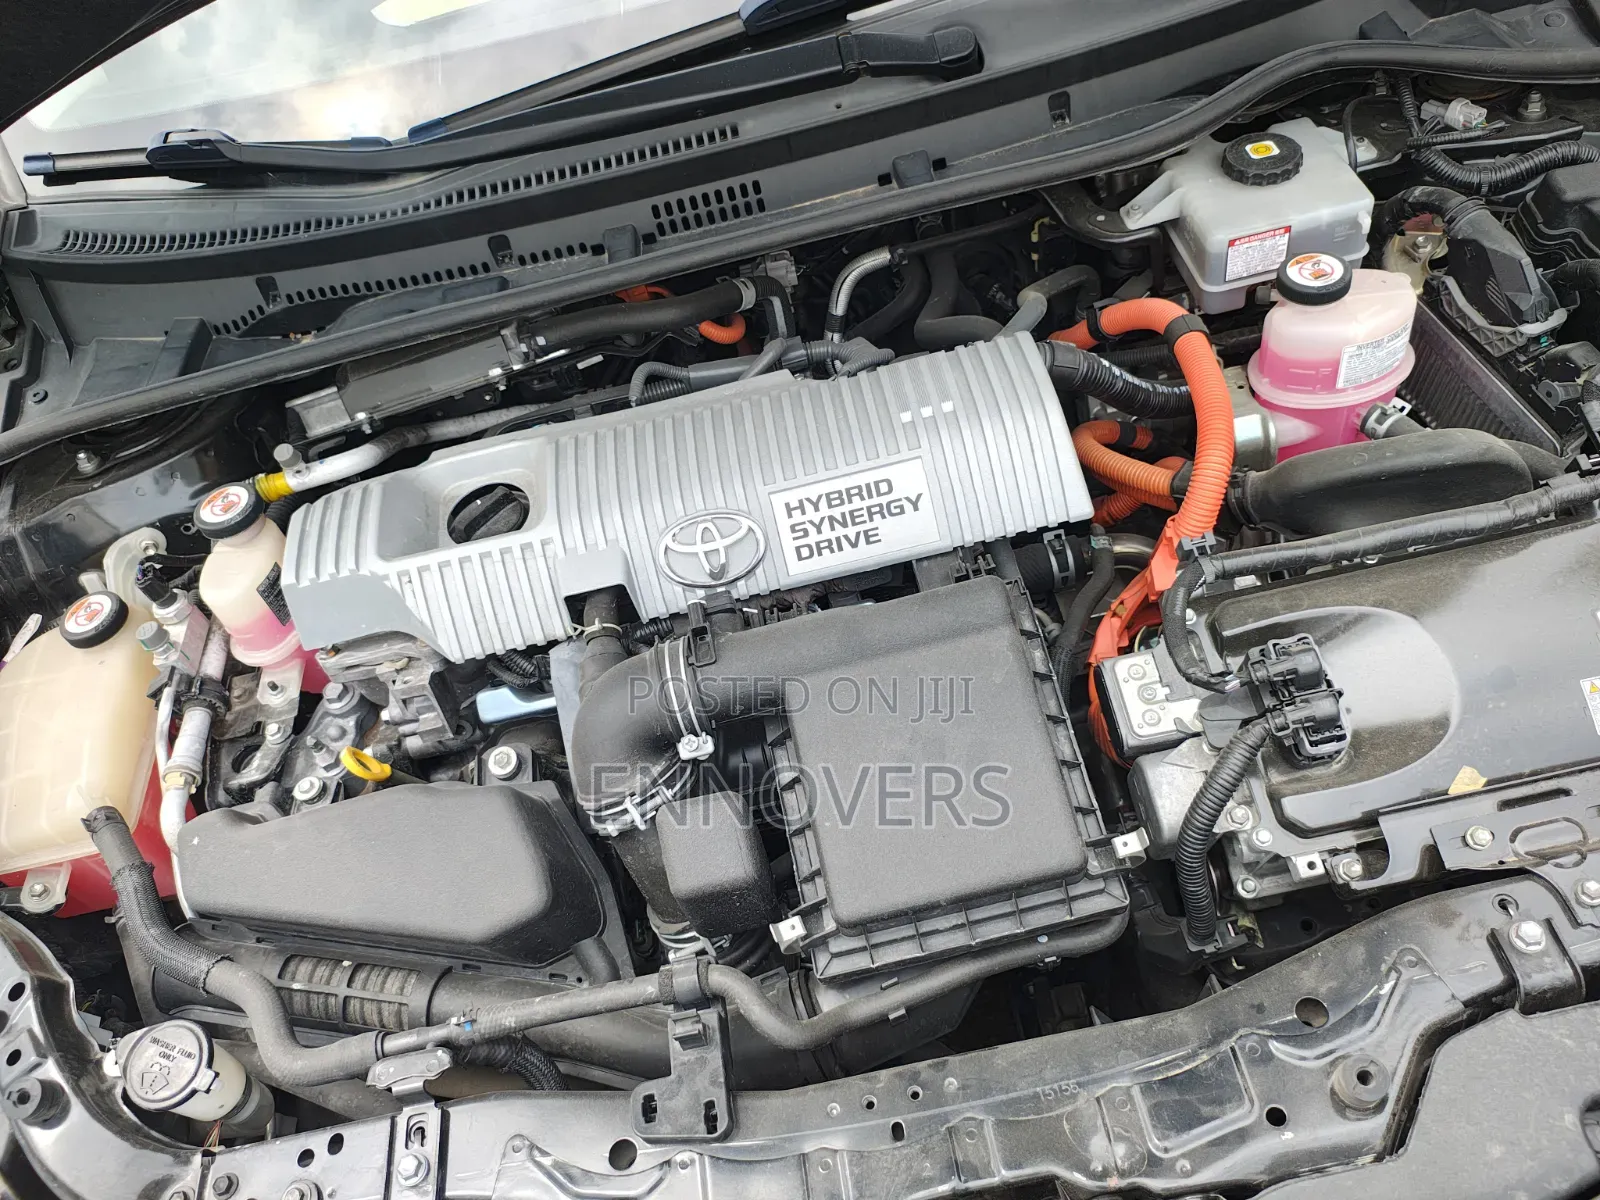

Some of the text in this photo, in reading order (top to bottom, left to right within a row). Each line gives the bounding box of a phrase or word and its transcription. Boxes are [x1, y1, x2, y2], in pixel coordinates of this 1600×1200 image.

[784, 478, 894, 519] HYBRID
[789, 493, 923, 541] SYNERGY
[794, 526, 882, 562] DRIVE
[149, 1036, 196, 1060] WASHER FLUID
[158, 1051, 177, 1062] ONLY
